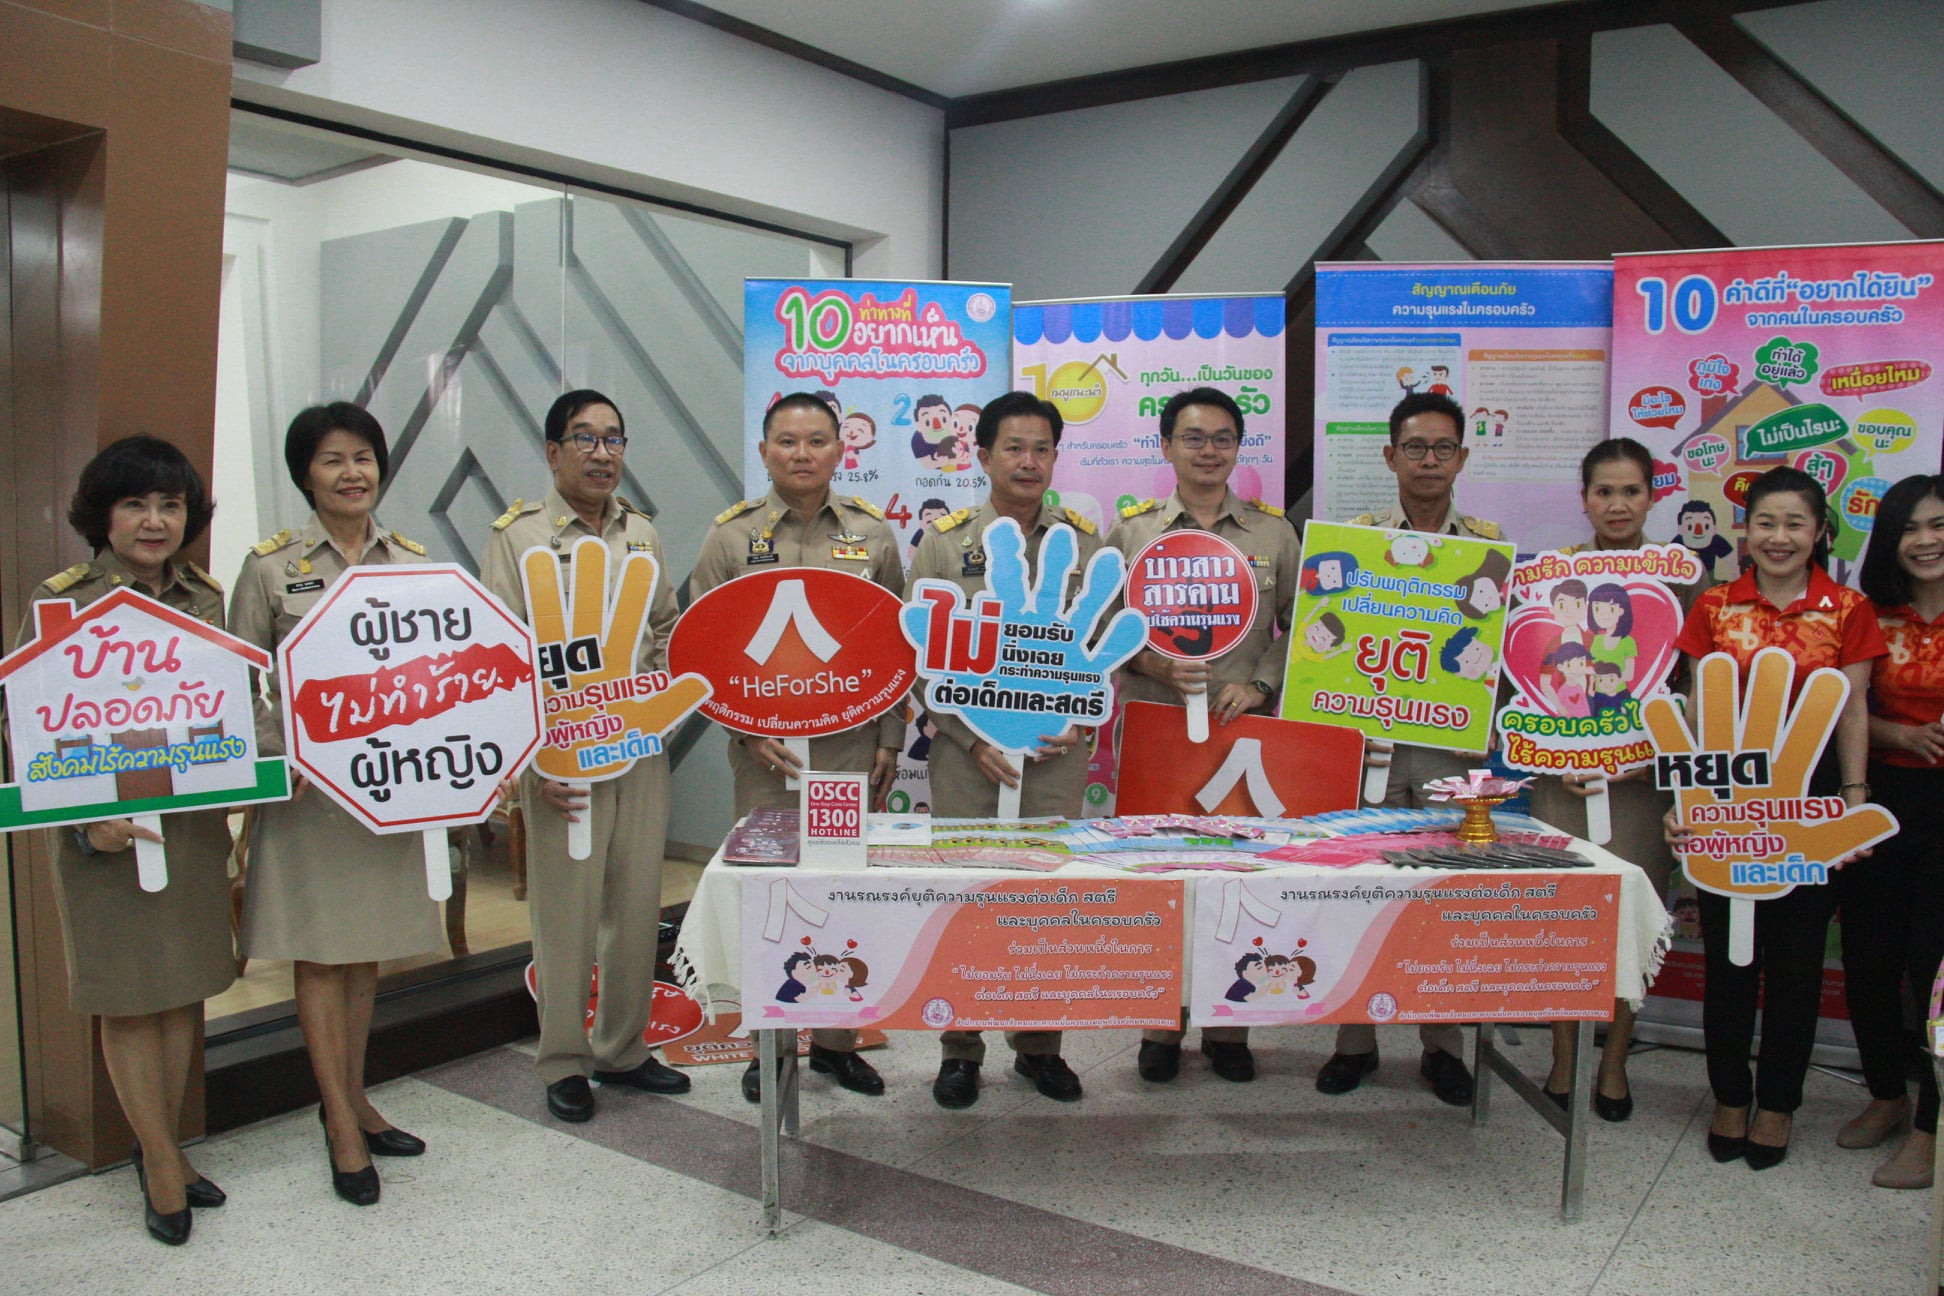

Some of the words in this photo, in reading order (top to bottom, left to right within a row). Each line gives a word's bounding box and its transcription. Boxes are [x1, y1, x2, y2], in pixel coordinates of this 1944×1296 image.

[1411, 280, 1516, 296] สัญญาณเตือนภัย
[1392, 301, 1536, 320] ความรุนแรงในครอบครัว
[1638, 276, 1717, 333] 10
[1748, 306, 1904, 327] จากคนในครอบครัว
[782, 292, 851, 352] 10
[859, 294, 912, 321] ท่าทางที่
[854, 308, 958, 348] อยากเห็น
[782, 347, 980, 379] จากบุคคลในครอบครัว
[1772, 349, 1802, 363] ทำได้
[1832, 365, 1921, 391] เหนื่อยไหม
[891, 393, 911, 426] 2
[885, 493, 912, 529] 4
[1144, 544, 1236, 579] บ่าวสาว
[1514, 557, 1570, 586] ามรัก
[1575, 549, 1695, 579] ความเข้าใจ
[1143, 582, 1240, 606] สารคาม
[1346, 571, 1467, 600] ปรับพฤติกรรม
[1342, 595, 1463, 626] เปลี่ยนความคิด
[350, 597, 472, 661] ผู้ชาย
[923, 589, 1001, 675] ไม่
[1003, 622, 1074, 642] ยอมรับ
[64, 625, 182, 679] บ้าน
[539, 637, 601, 690] ยุด
[1002, 641, 1064, 666] นิ่งเฉย
[1356, 630, 1431, 691] ยุติ
[999, 665, 1100, 685] กระทำความรุนแรง
[36, 680, 225, 733] ปลอดภัย
[319, 660, 500, 734] ไม่ทำร้าย
[757, 714, 839, 730] เปลี่ยนความคิด
[842, 668, 907, 725] ยุติความรุนแรง
[935, 678, 1104, 716] ต่อเด็กและสตรี
[1313, 690, 1470, 729] ความรุนแรง
[28, 737, 246, 781] สังคมไร้ความรุนแรง
[579, 731, 661, 771] และเด็ก
[1507, 735, 1654, 774] ไร้ความรุนแ
[350, 734, 503, 803] ผู้หญิง
[1657, 752, 1770, 799] หยุด
[810, 782, 859, 801] OSCC
[809, 808, 858, 828] 1300
[1691, 798, 1845, 828] ความรุนแรง
[811, 828, 857, 836] HOTLINE
[1731, 856, 1826, 884] และเด็ก
[828, 887, 1078, 908] งานรณรงค์ยุติความรุนแรงต่อเด็ก
[1083, 889, 1116, 904] สตรี
[1280, 884, 1521, 904] งานรณรงค์ยุติความรุนแรงต่อเด็ก
[1525, 884, 1556, 898] สตรี
[998, 910, 1161, 932] และบุคคลในครอบครัว
[1442, 905, 1598, 926] และบุคคลในครอบครัว
[1008, 935, 1153, 955] ร่วมเป็นส่วนหนึ่งในการ
[1451, 930, 1588, 949] ร่วมเป็นส่วนหนึ่งในการ
[692, 1052, 751, 1063] WHITE
